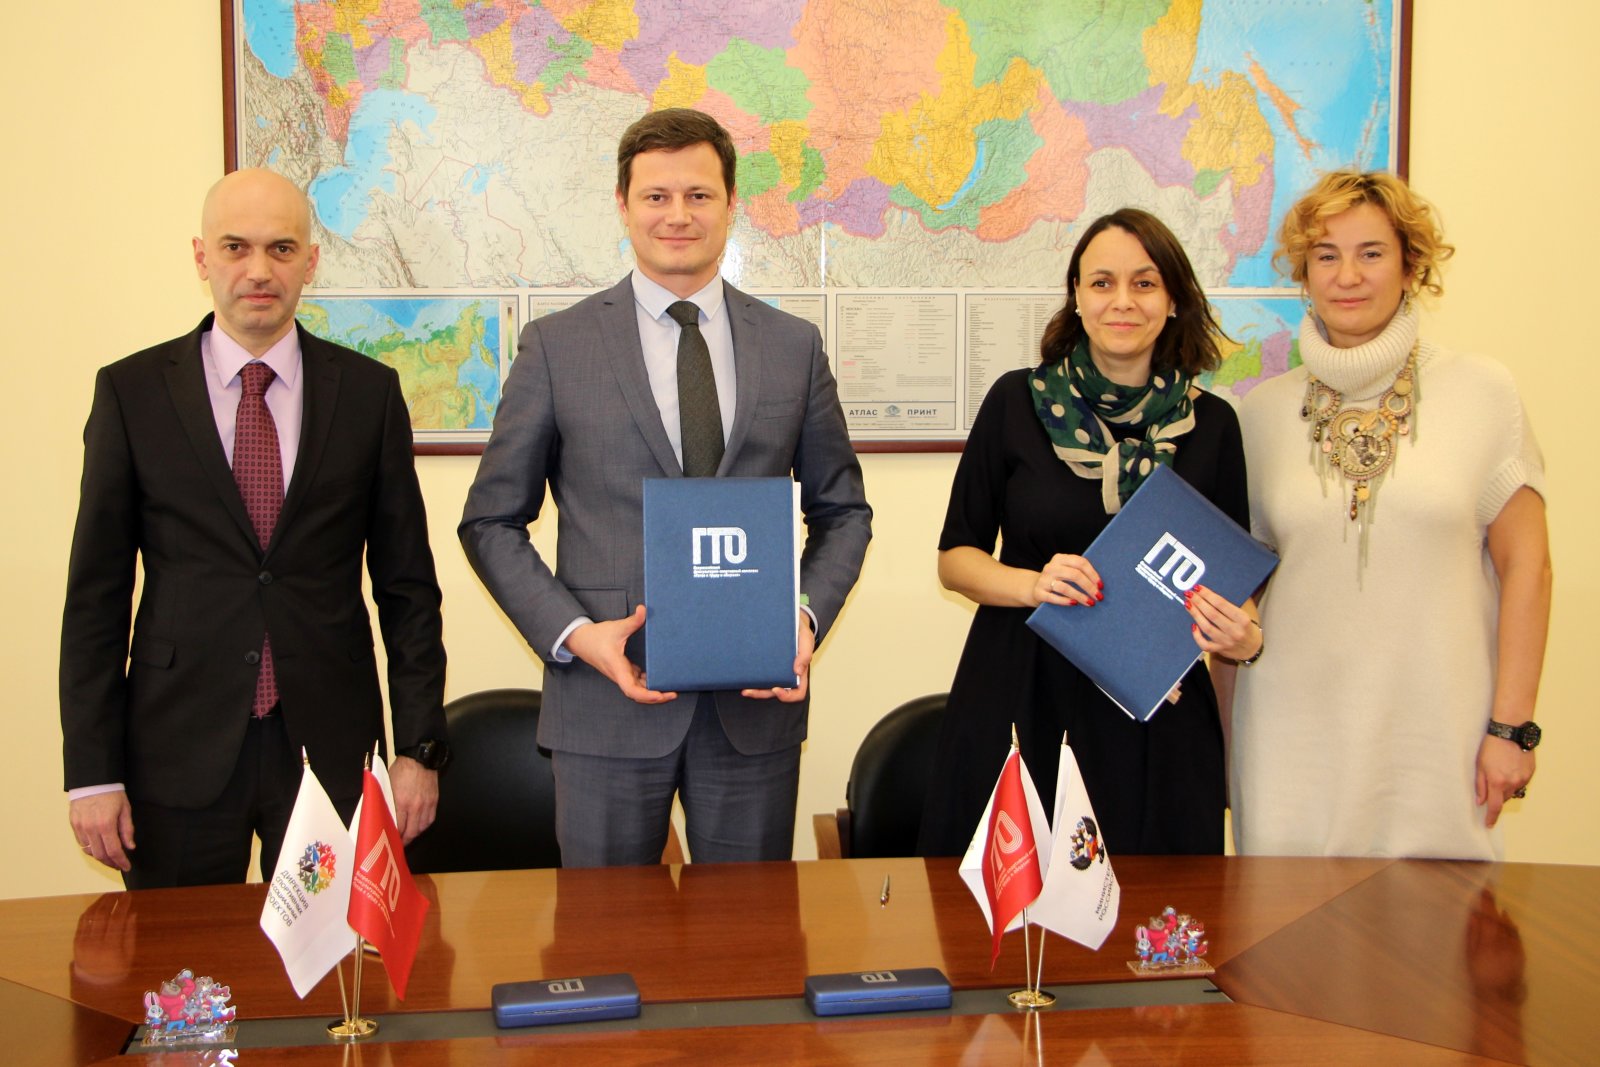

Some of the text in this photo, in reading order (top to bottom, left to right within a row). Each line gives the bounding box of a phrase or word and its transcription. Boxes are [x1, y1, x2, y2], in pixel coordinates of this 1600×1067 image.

[692, 527, 747, 565] ГТО
[1143, 531, 1206, 591] ГТО
[267, 891, 293, 927] РОЕКТОВ
[275, 876, 303, 915] СПОРТИВНЫХ
[281, 870, 309, 910] ДИРЕКЦИЯ
